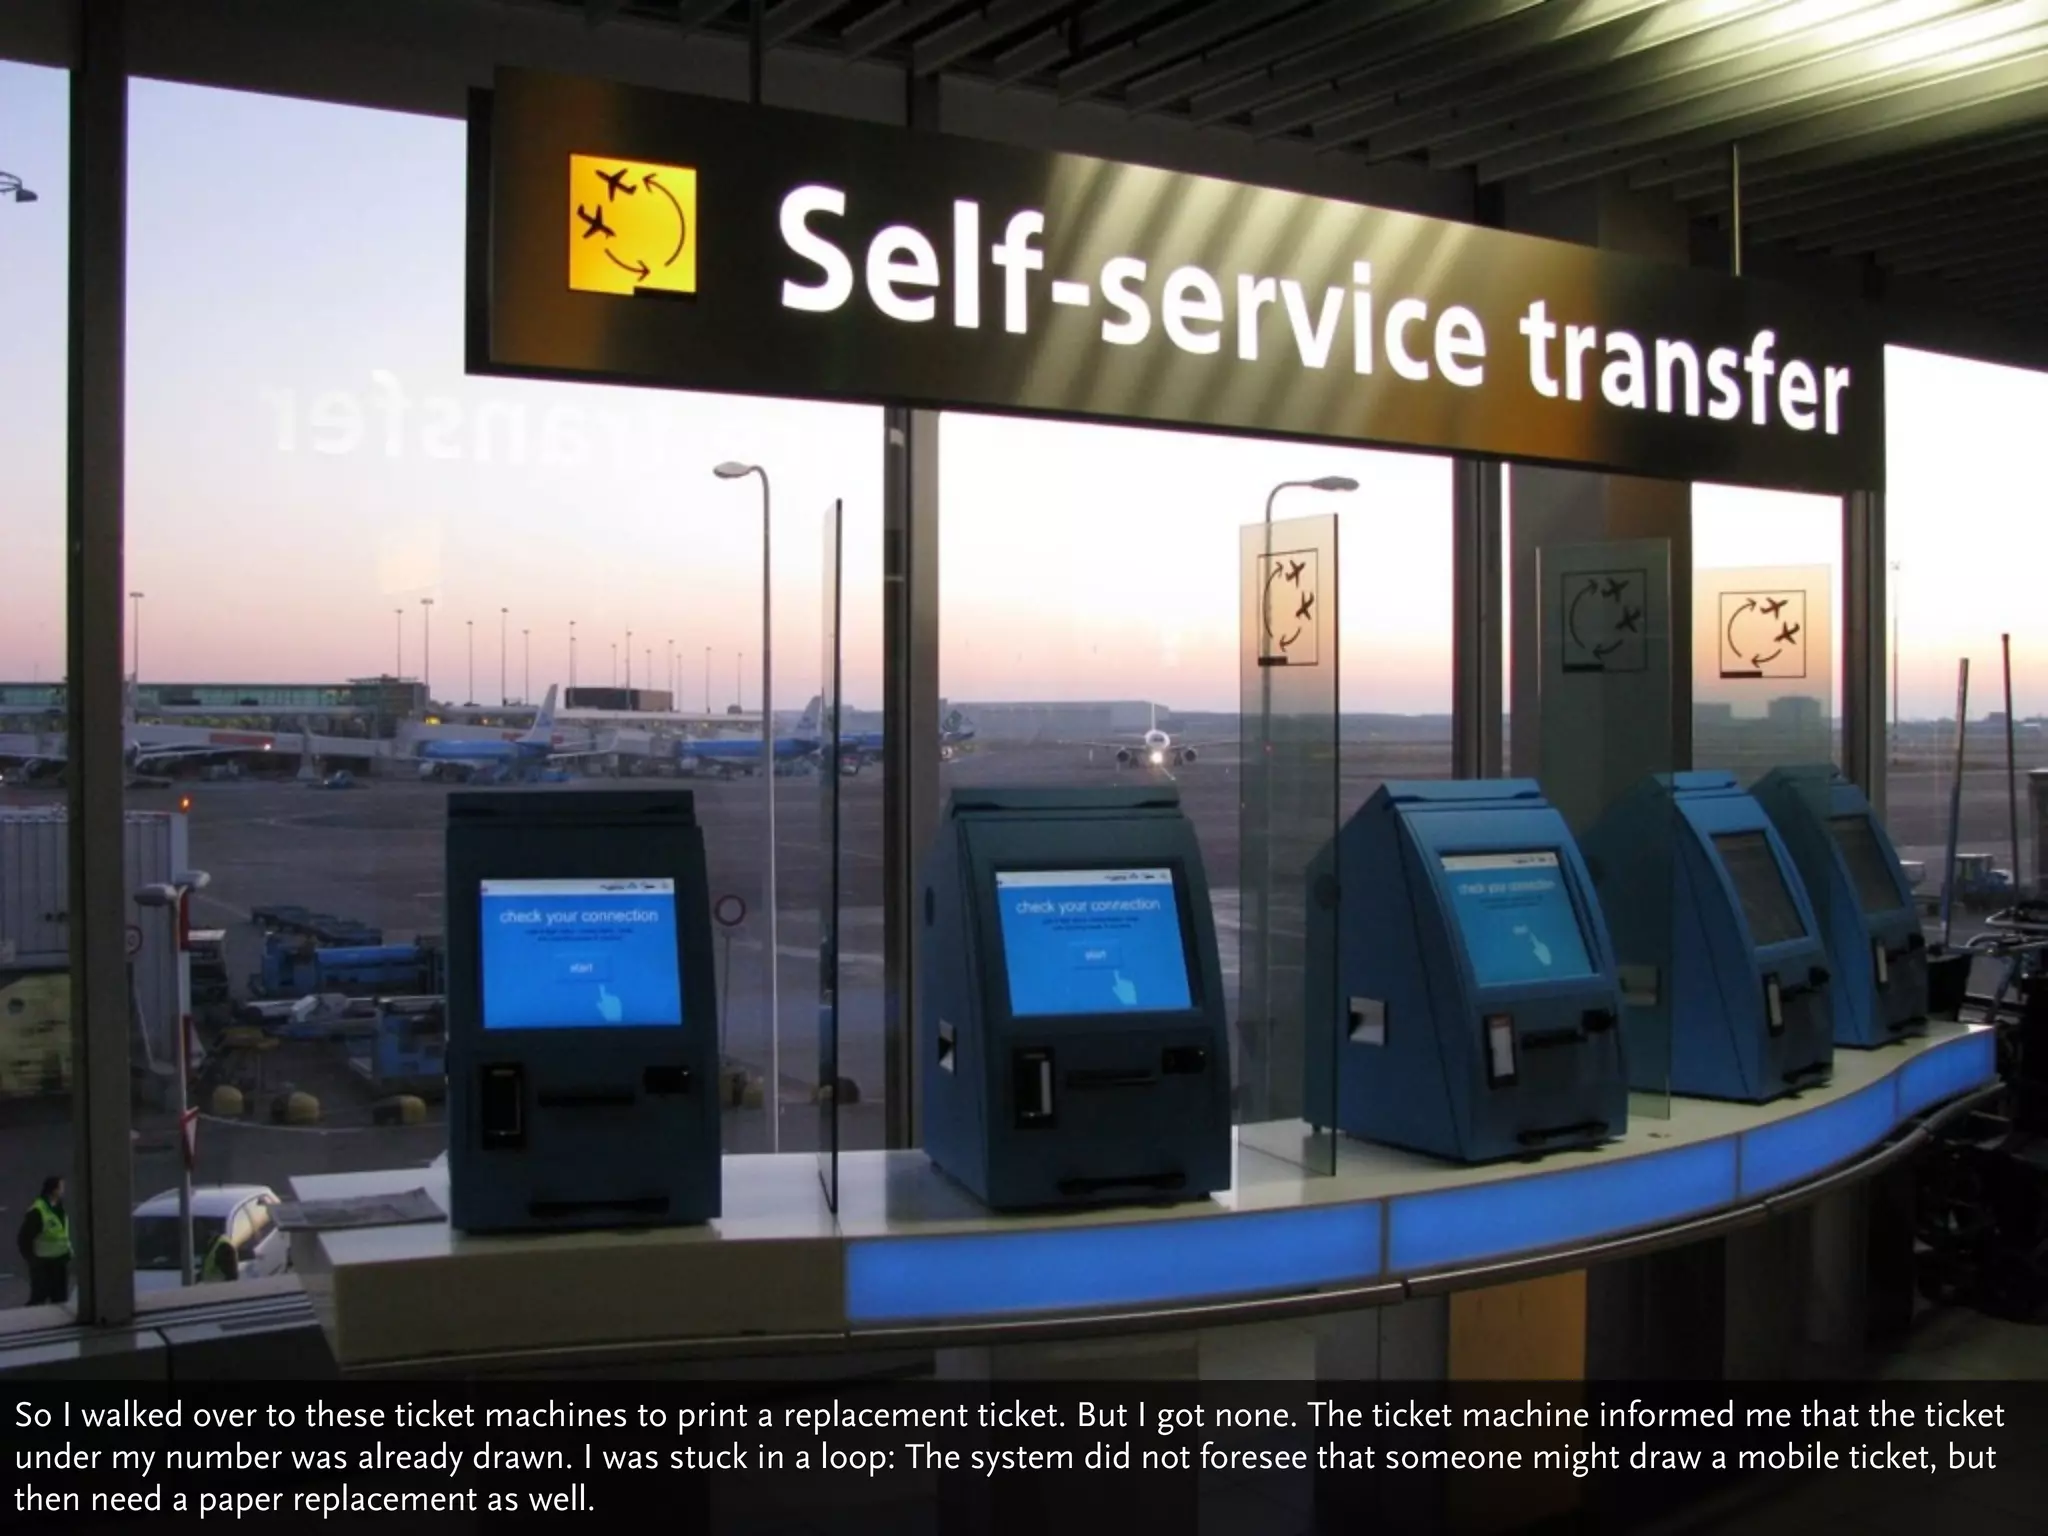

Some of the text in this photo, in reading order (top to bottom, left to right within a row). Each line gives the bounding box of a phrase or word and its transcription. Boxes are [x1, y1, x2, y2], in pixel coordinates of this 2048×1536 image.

[778, 185, 1851, 436] Self-service transfer
[1015, 897, 1161, 915] check your connection
[499, 907, 659, 926] check your connection
